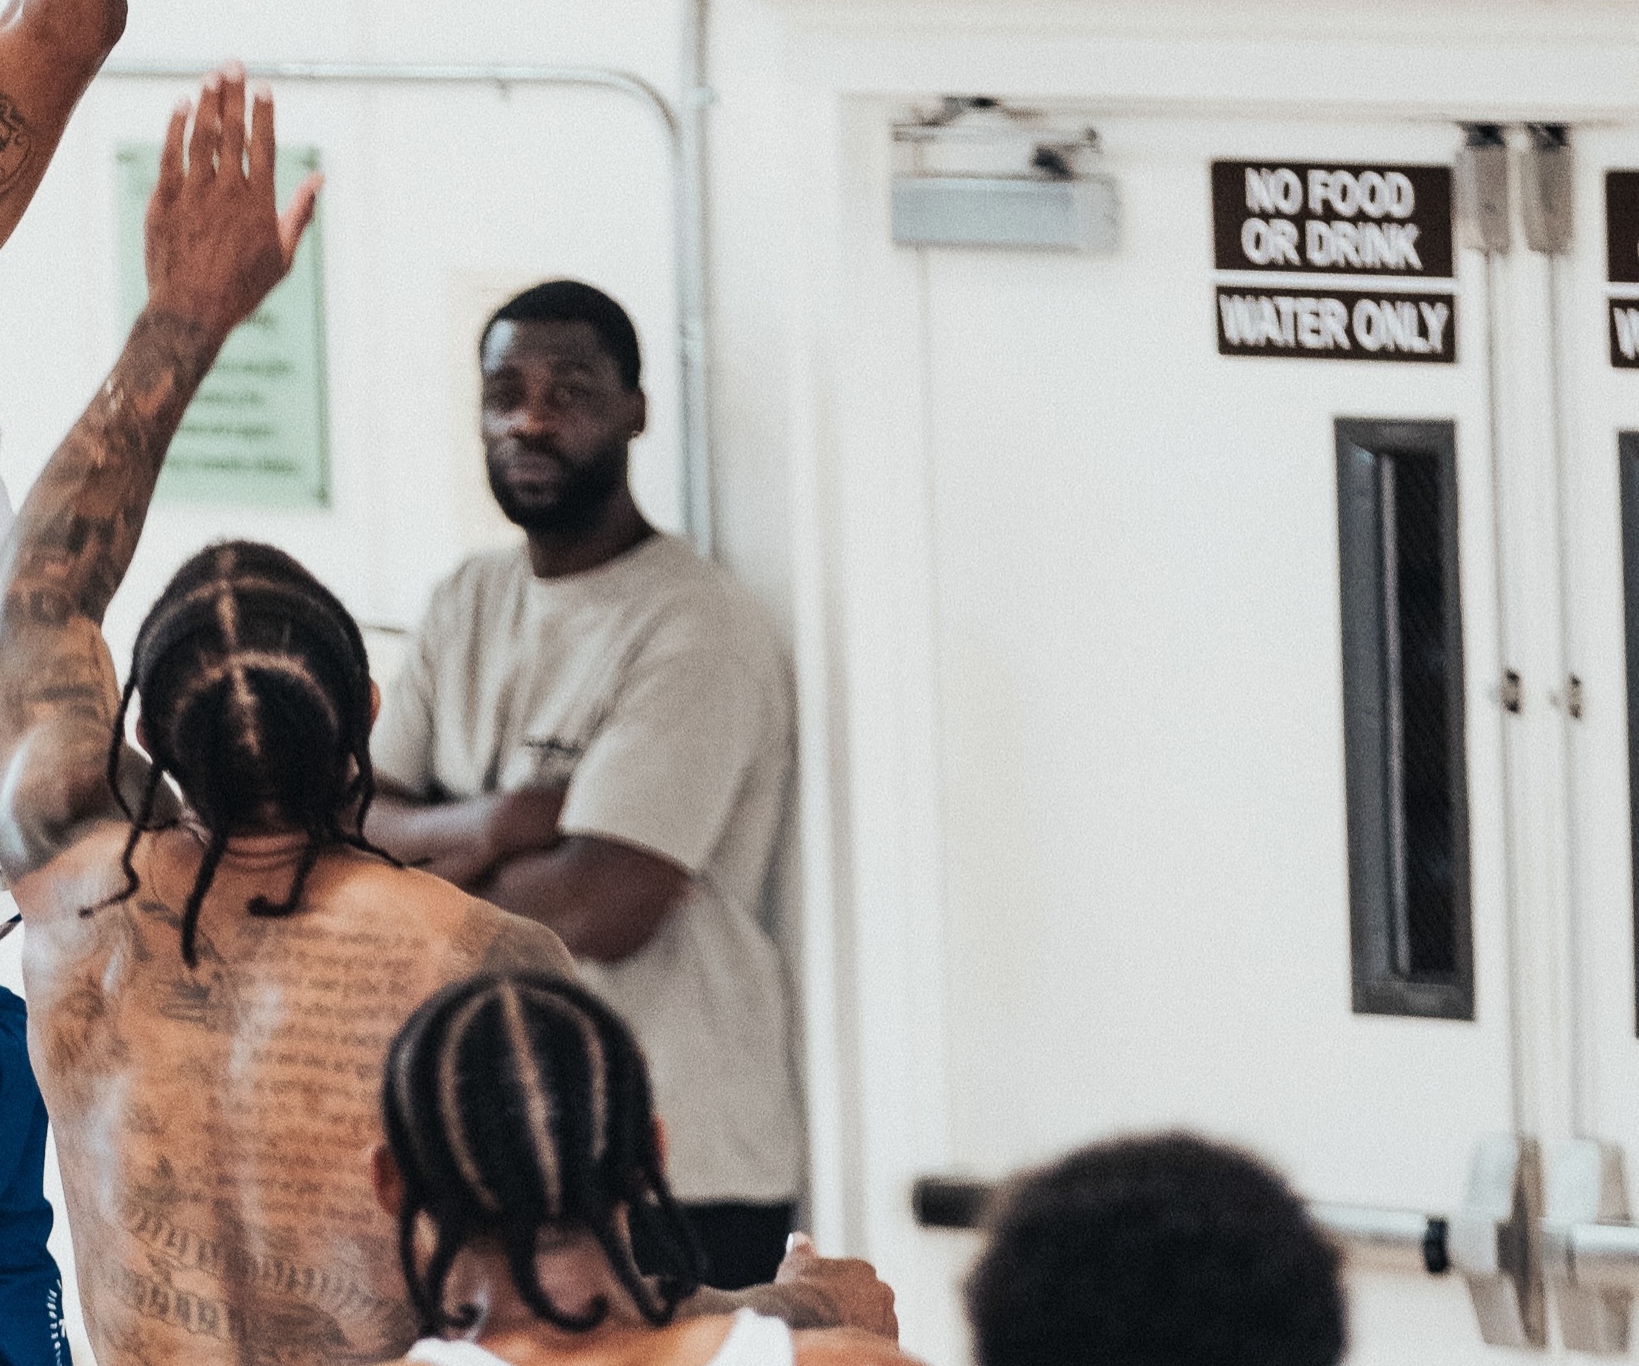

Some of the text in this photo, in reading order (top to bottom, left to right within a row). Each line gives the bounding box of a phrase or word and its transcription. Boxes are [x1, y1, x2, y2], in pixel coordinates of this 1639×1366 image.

[1244, 167, 1416, 219] NO FOOD
[1240, 217, 1424, 271] OR DRINK
[1219, 294, 1450, 354] WATER ONLY
